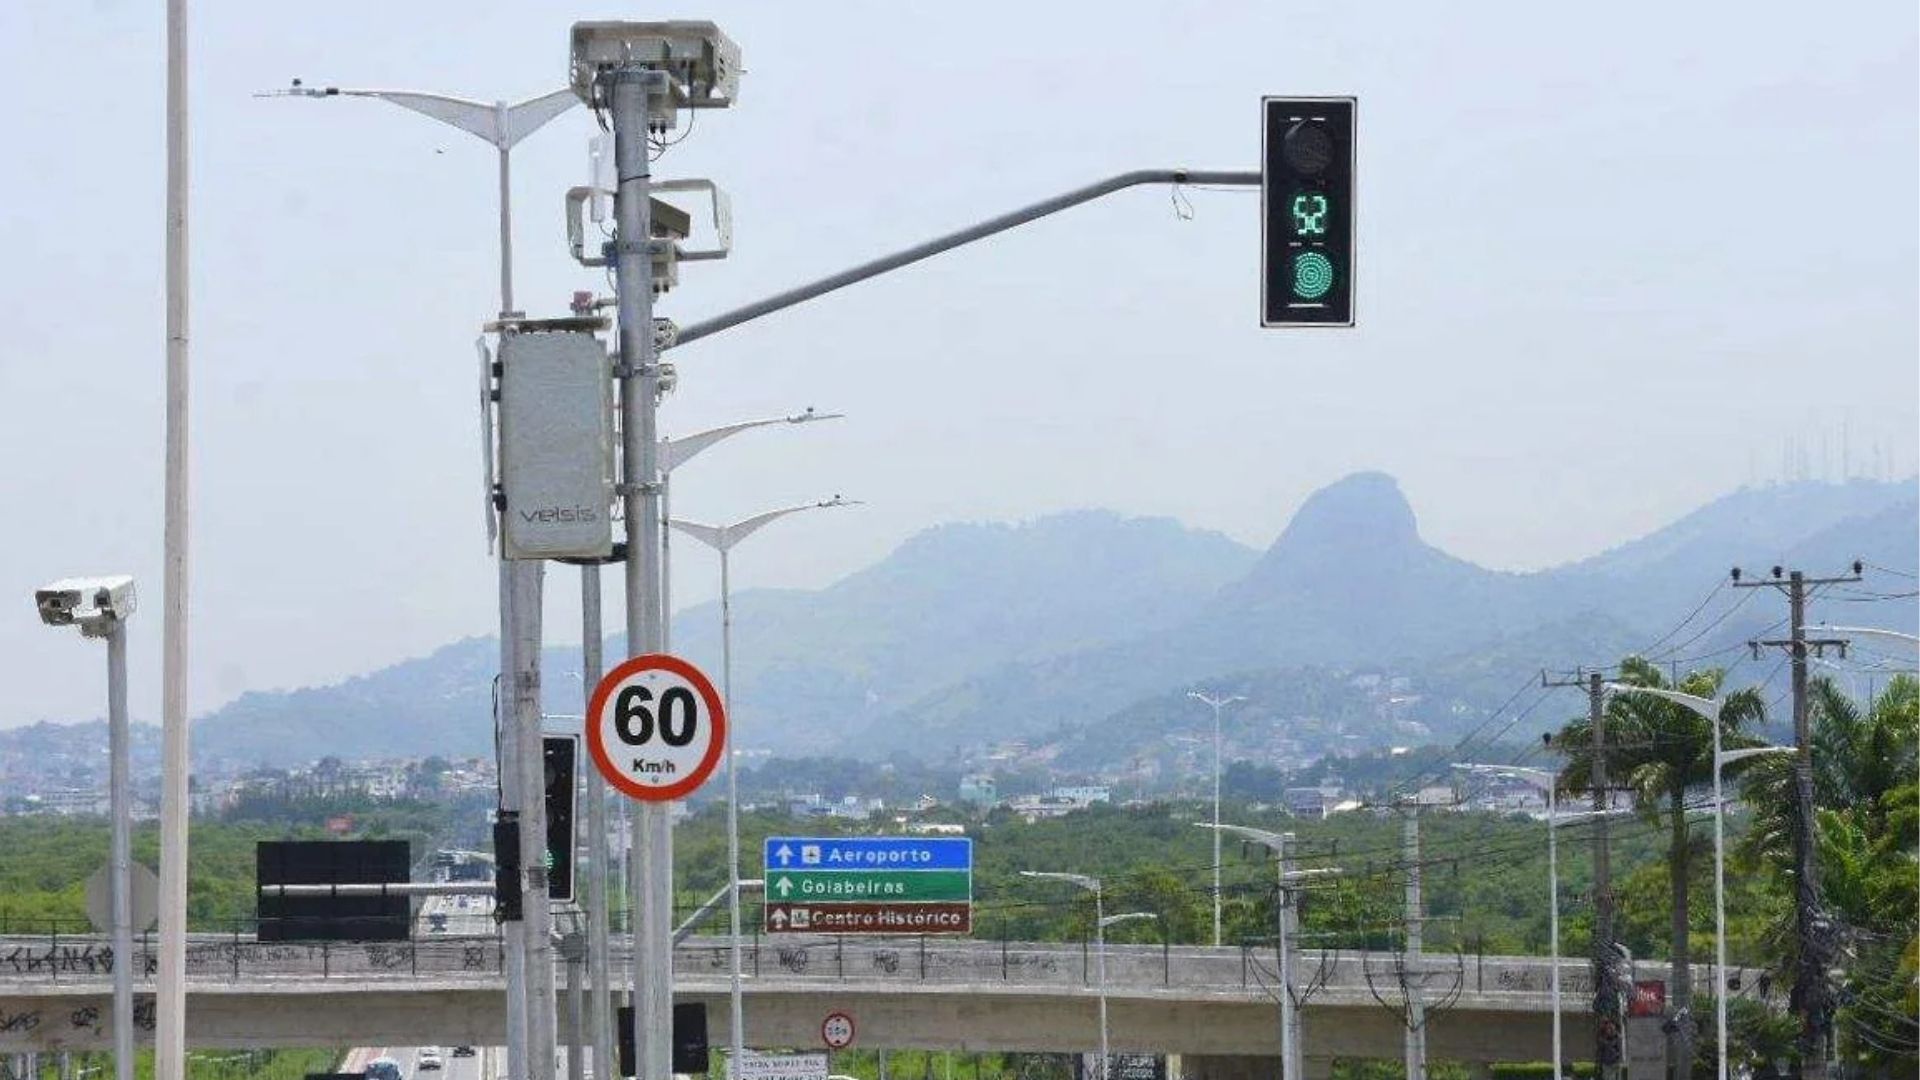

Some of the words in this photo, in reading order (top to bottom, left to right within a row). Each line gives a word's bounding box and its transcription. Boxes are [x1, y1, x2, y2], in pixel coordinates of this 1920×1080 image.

[521, 504, 596, 523] velsis
[614, 685, 698, 746] 60
[632, 759, 676, 773] Km/h
[828, 847, 931, 864] Aeroporto
[801, 879, 904, 894] Goiabeiras
[812, 911, 873, 924] Centro
[878, 908, 961, 925] Histórico
